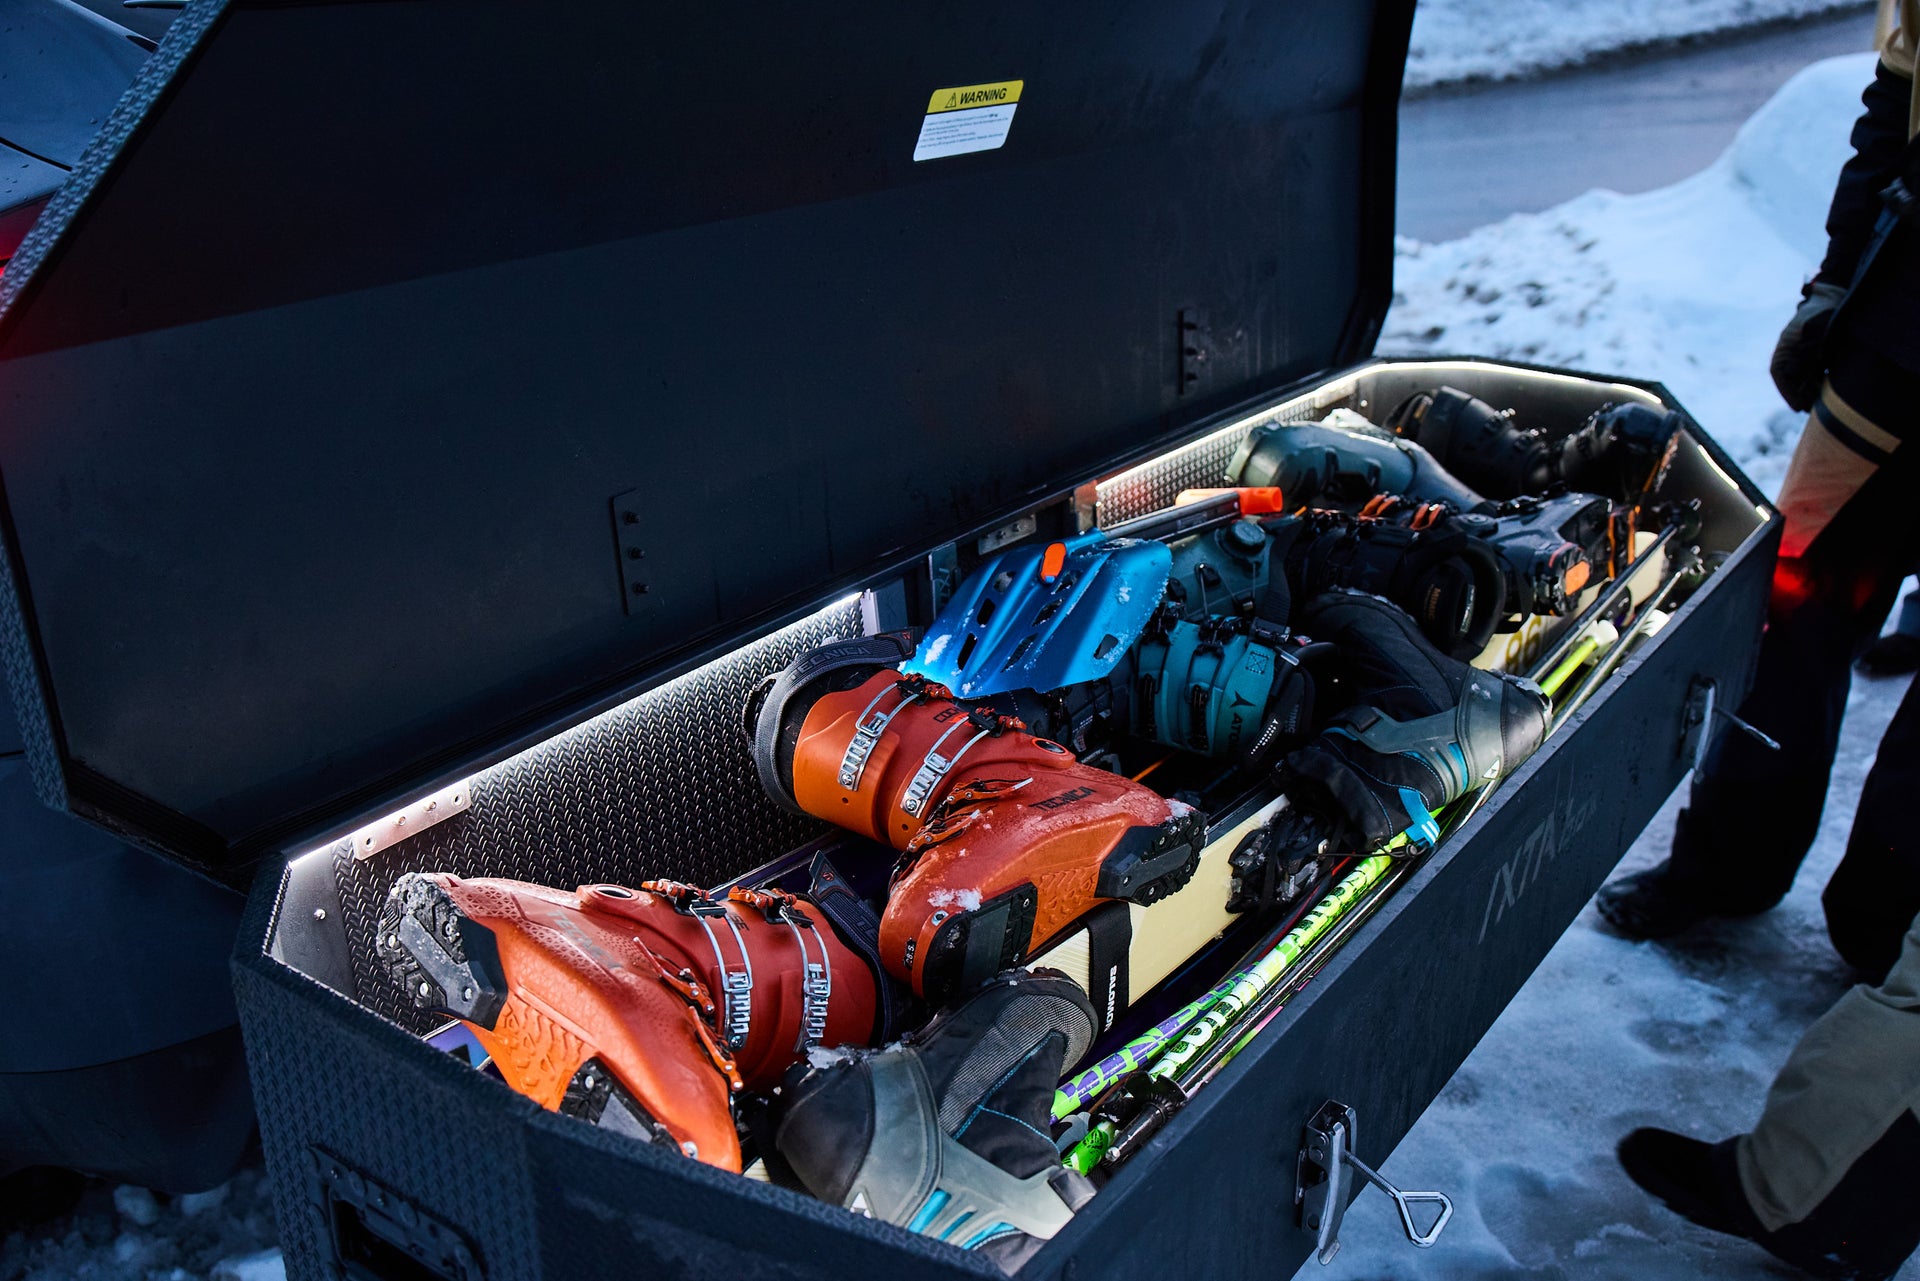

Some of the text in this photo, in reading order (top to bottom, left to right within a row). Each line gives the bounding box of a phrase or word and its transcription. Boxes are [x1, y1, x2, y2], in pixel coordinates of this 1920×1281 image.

[959, 87, 1008, 106] WARNING
[786, 645, 873, 684] TECNICA
[1028, 786, 1097, 811] TECNICA
[1103, 964, 1118, 1033] SALOMON
